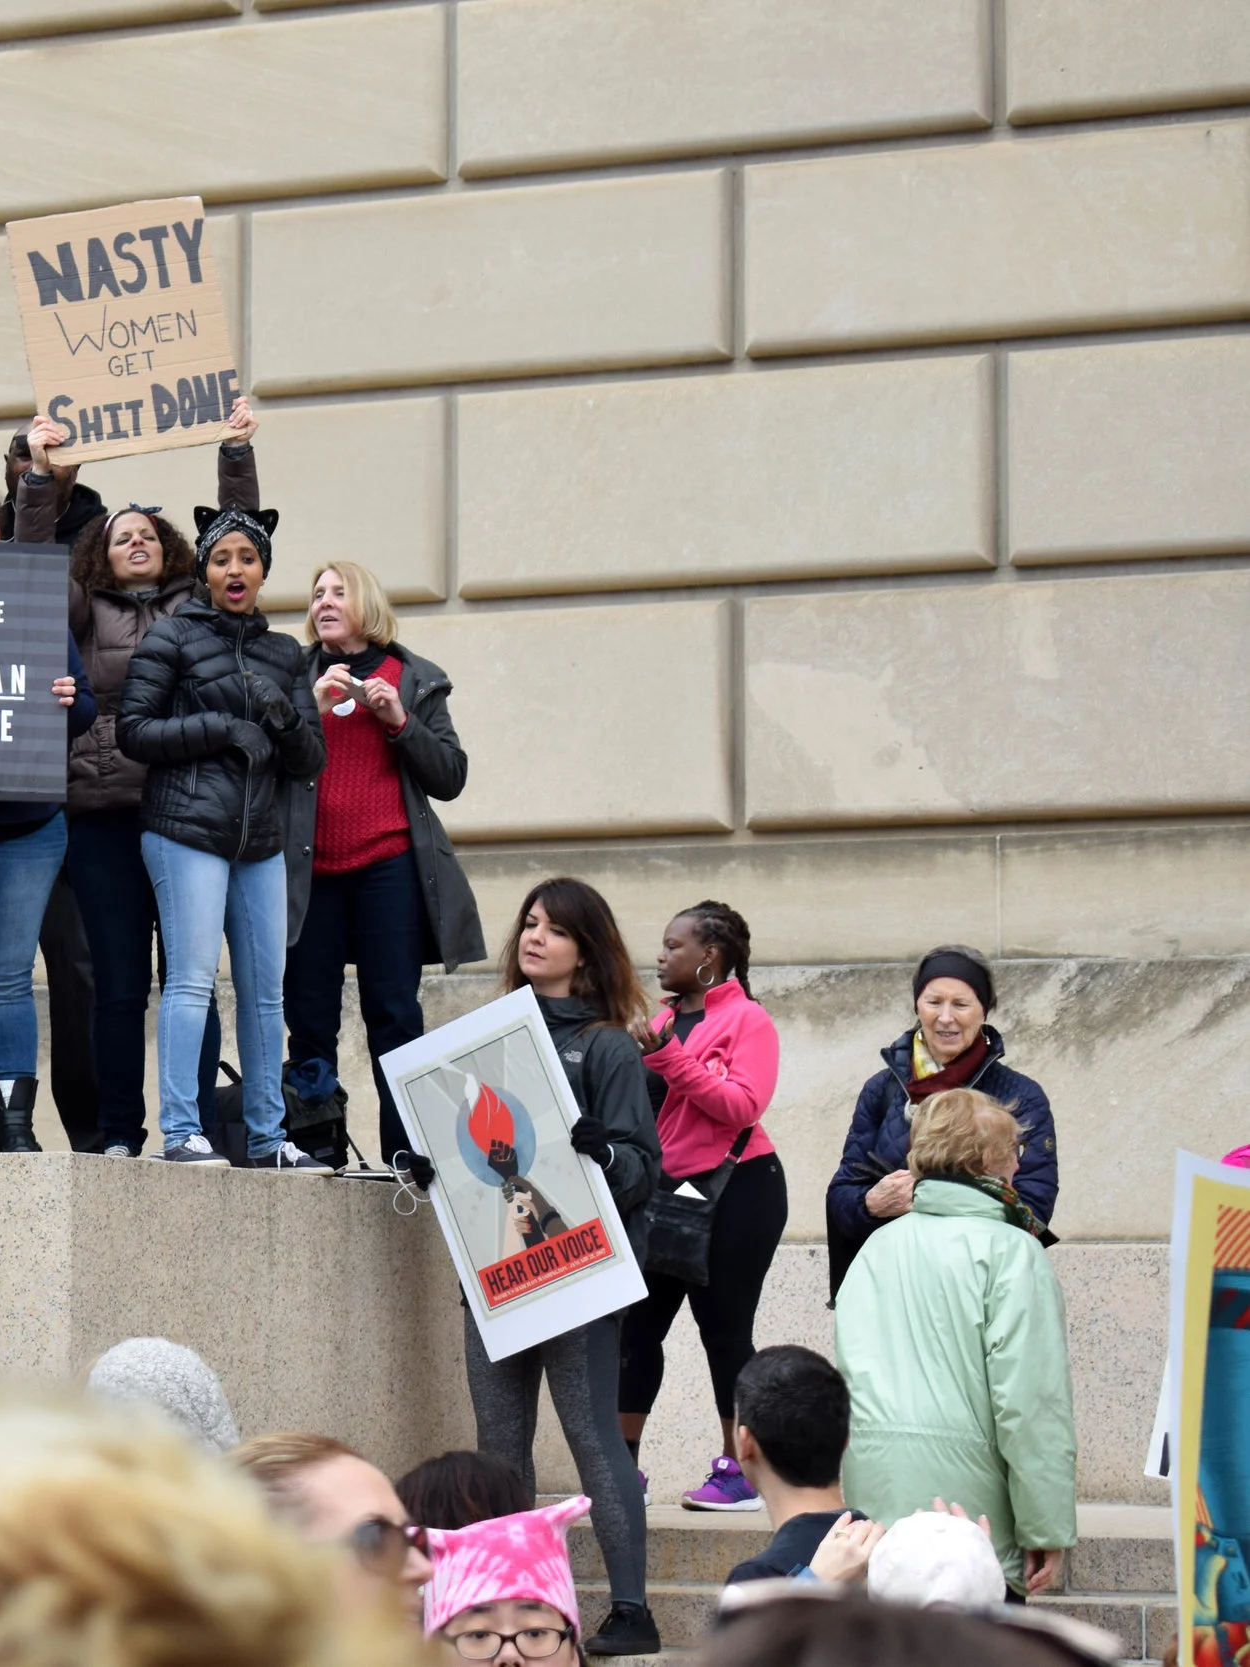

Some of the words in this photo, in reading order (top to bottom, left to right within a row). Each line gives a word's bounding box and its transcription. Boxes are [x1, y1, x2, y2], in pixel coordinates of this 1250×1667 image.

[26, 218, 204, 307] NASTY
[53, 304, 197, 356] WOMEN
[108, 350, 155, 377] GET
[47, 394, 144, 448] SHIT
[150, 369, 241, 434] DONE
[485, 1259, 529, 1296] HEAR
[526, 1246, 560, 1278] OUR
[556, 1225, 603, 1263] VOICE
